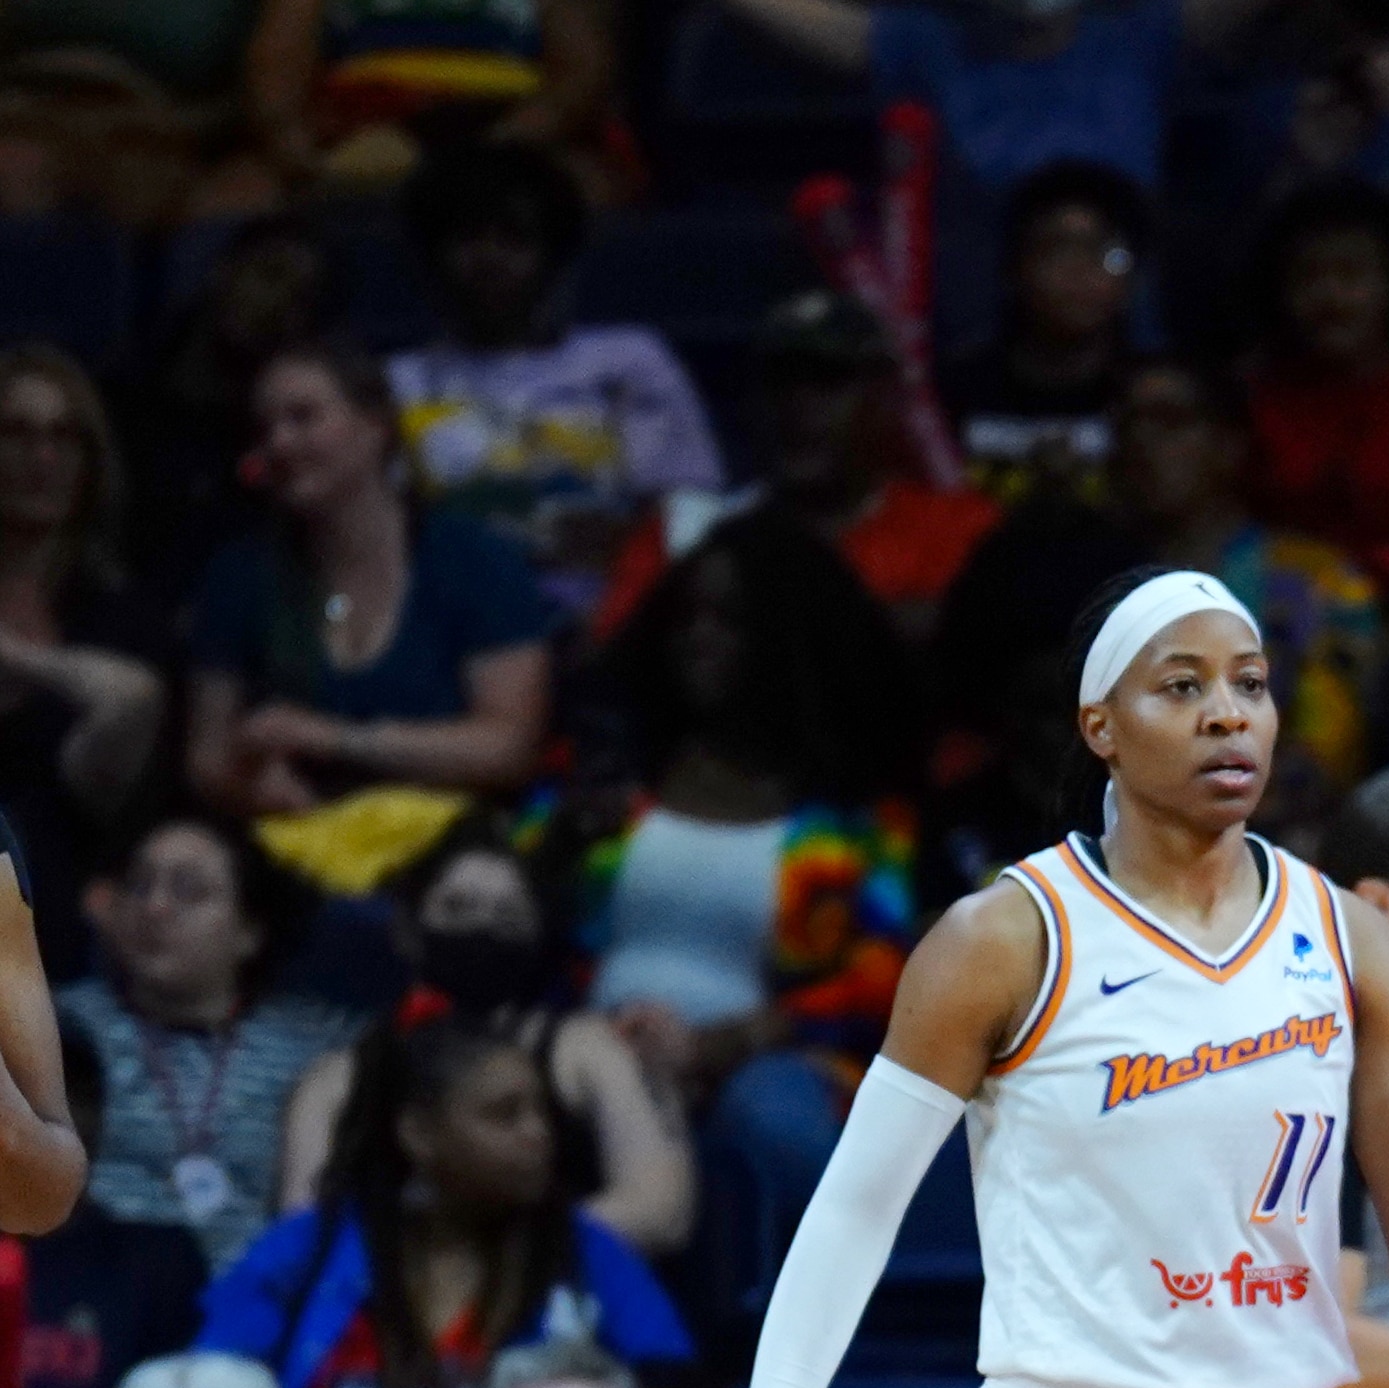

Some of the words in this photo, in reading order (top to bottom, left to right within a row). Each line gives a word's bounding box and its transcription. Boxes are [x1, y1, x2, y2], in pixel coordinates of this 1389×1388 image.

[1283, 966, 1332, 982] PayPal
[1099, 1012, 1343, 1116] Mercury
[1249, 1109, 1335, 1224] 11
